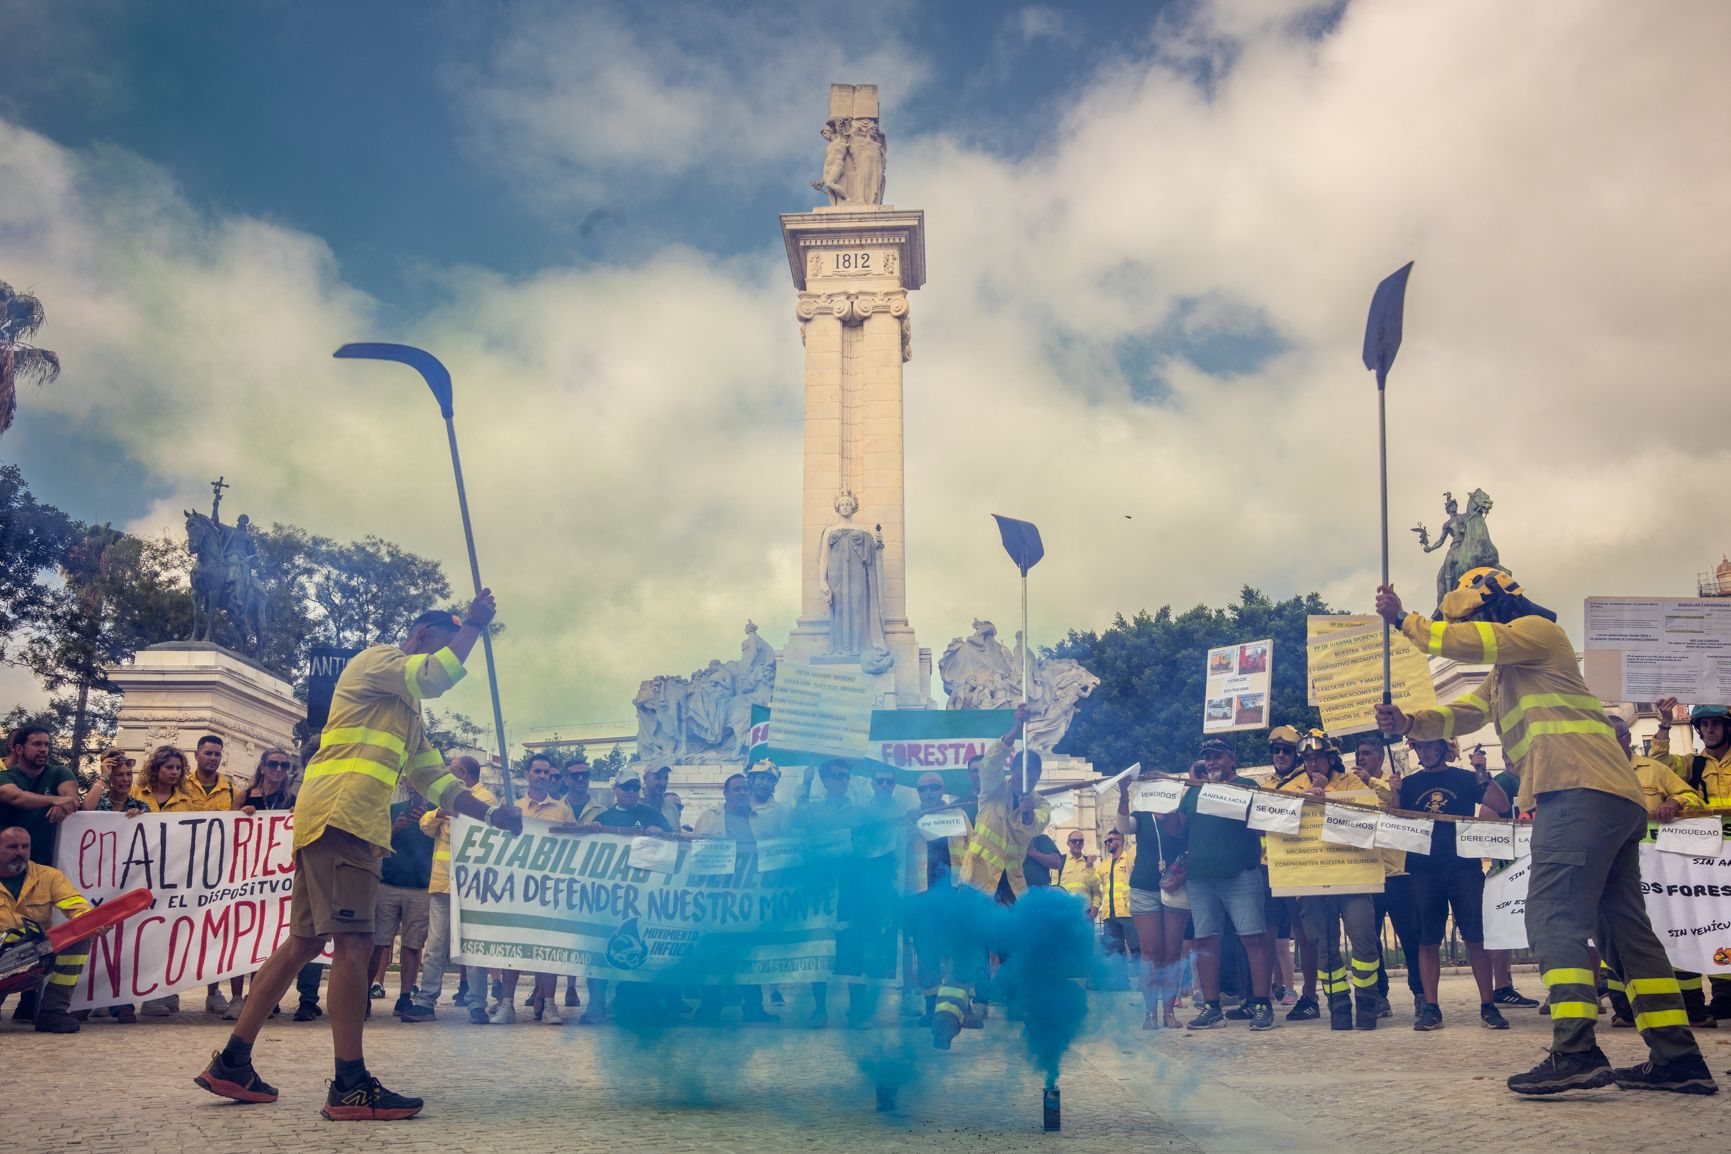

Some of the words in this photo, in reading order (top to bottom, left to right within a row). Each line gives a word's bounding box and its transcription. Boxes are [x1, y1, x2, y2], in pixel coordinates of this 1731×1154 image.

[835, 253, 870, 269] 1812
[1365, 675, 1384, 684] MATER
[1141, 791, 1177, 800] VENDIDOS
[1256, 804, 1266, 813] SE
[1326, 816, 1374, 830] BOMBEROS
[1380, 822, 1431, 836] FORESTALES
[1460, 834, 1510, 844] DERECHOS
[119, 818, 225, 890] ALTO
[1692, 858, 1714, 866] SIN
[1508, 870, 1525, 882] SIN
[455, 865, 516, 905] PARA
[523, 874, 642, 920] DEFENDER
[647, 887, 752, 926] NUESTRO
[168, 895, 188, 909] EL
[1496, 900, 1512, 910] SIN
[1668, 928, 1688, 938] SIN
[487, 943, 523, 959] JUSTAS
[532, 947, 592, 965] ESTABILIDAD
